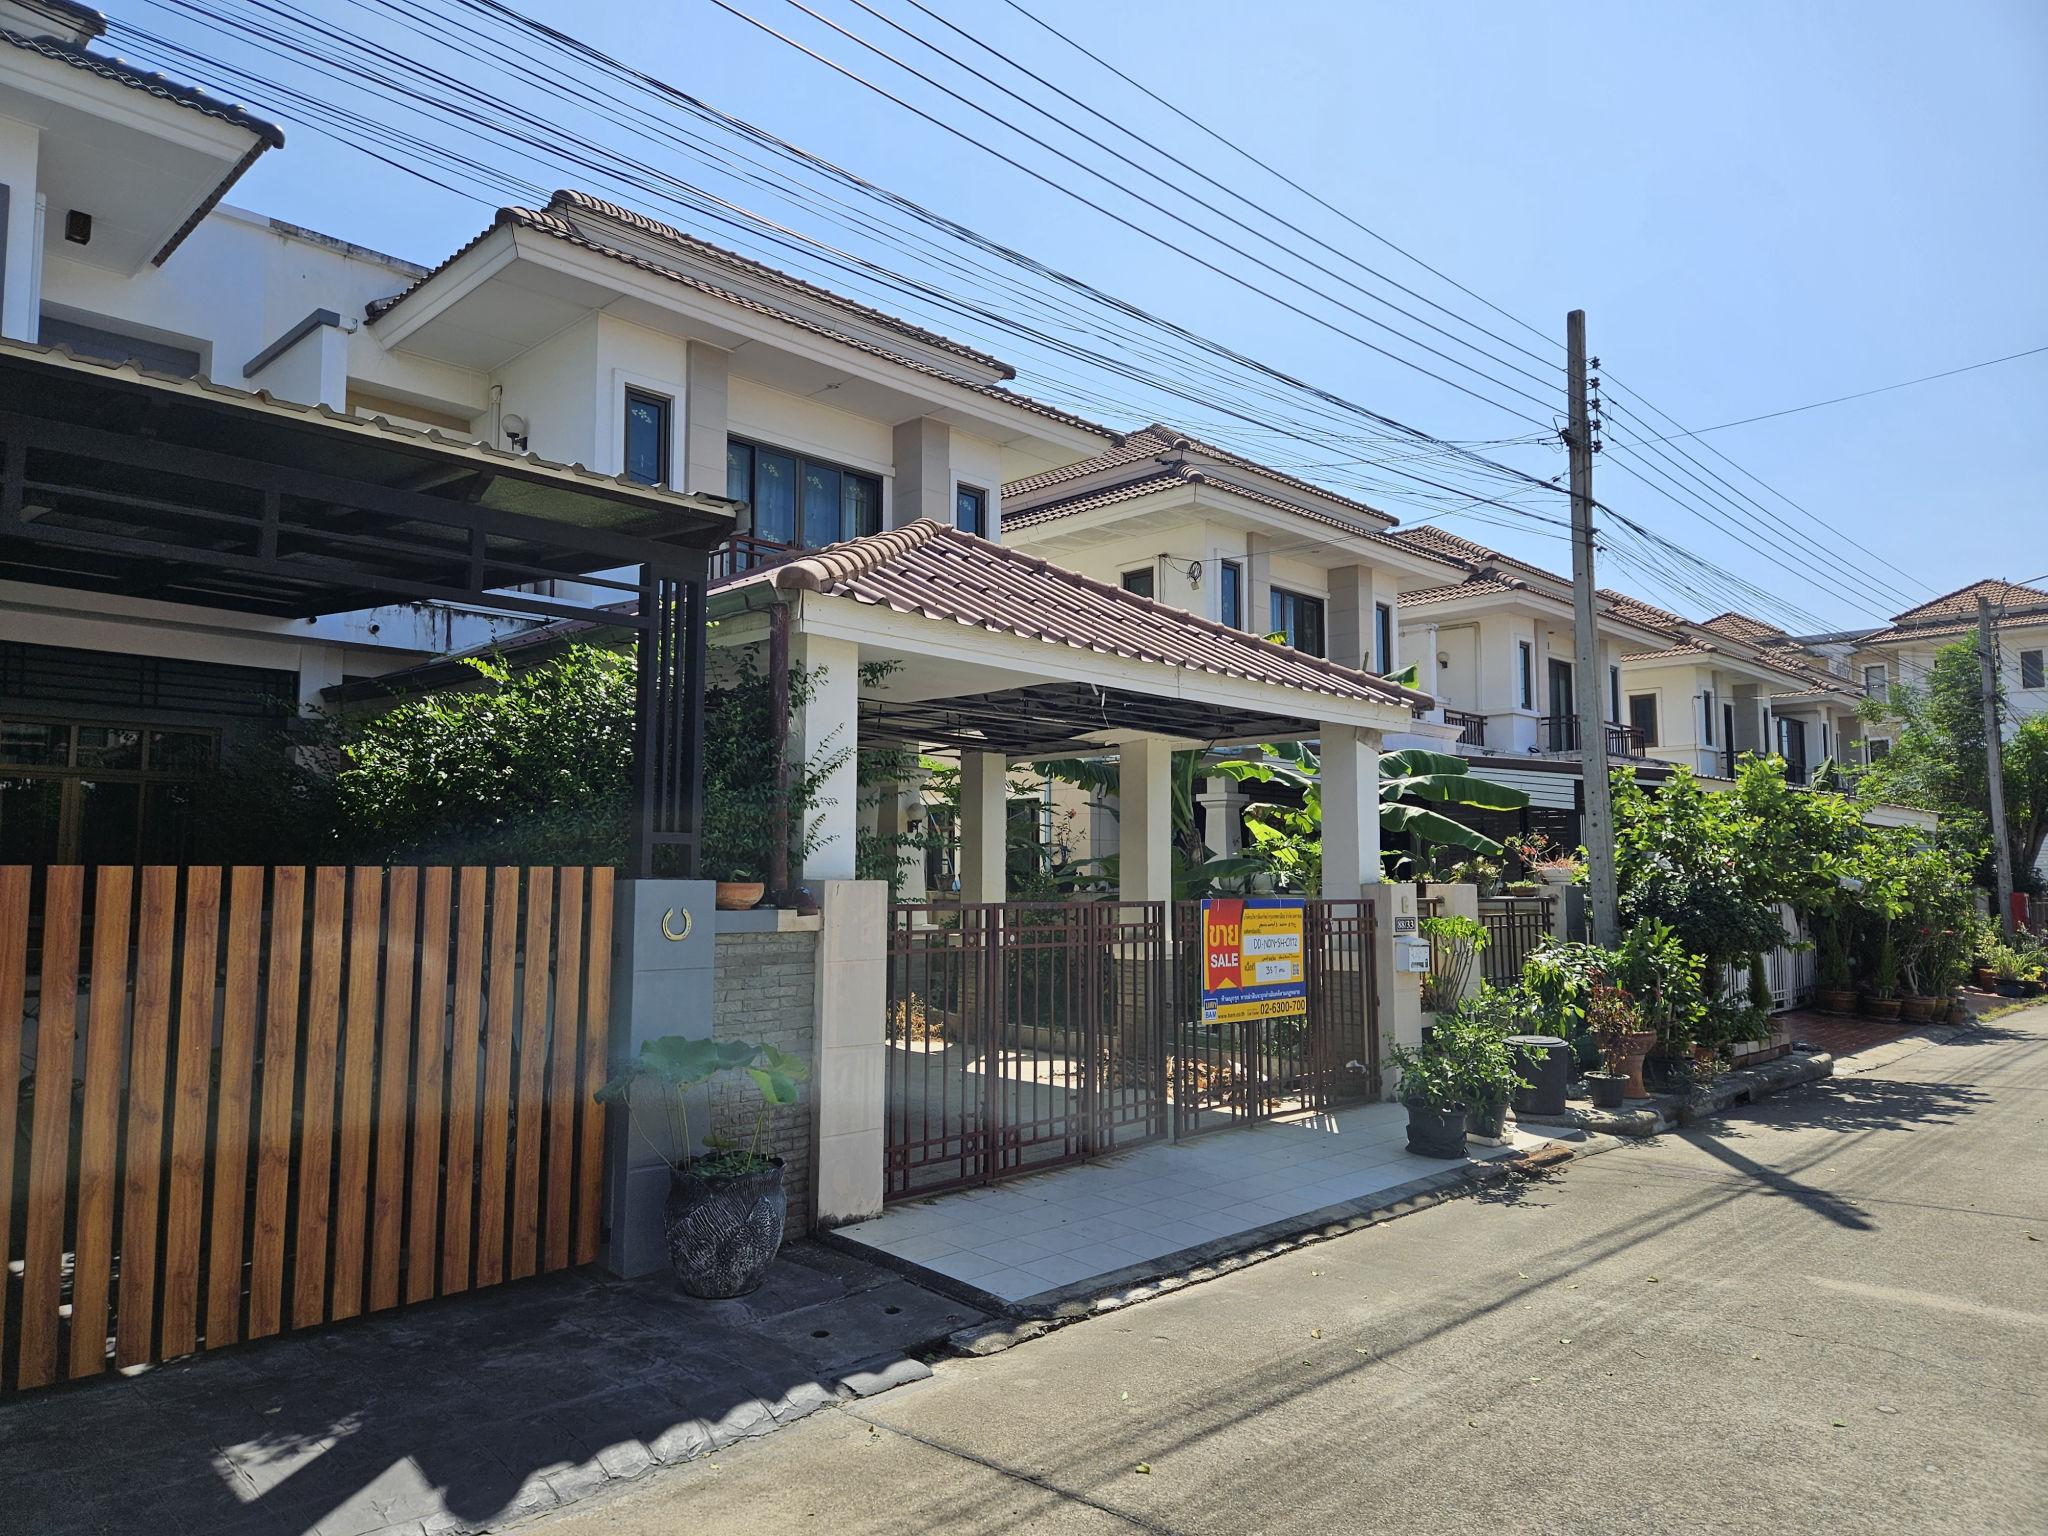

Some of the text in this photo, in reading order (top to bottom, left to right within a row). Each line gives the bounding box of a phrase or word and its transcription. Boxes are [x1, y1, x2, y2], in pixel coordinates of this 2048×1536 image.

[1397, 920, 1414, 929] 88/33
[1209, 924, 1239, 946] ขาย
[1211, 953, 1239, 968] SALE
[1260, 1000, 1305, 1014] 02-6300-700
